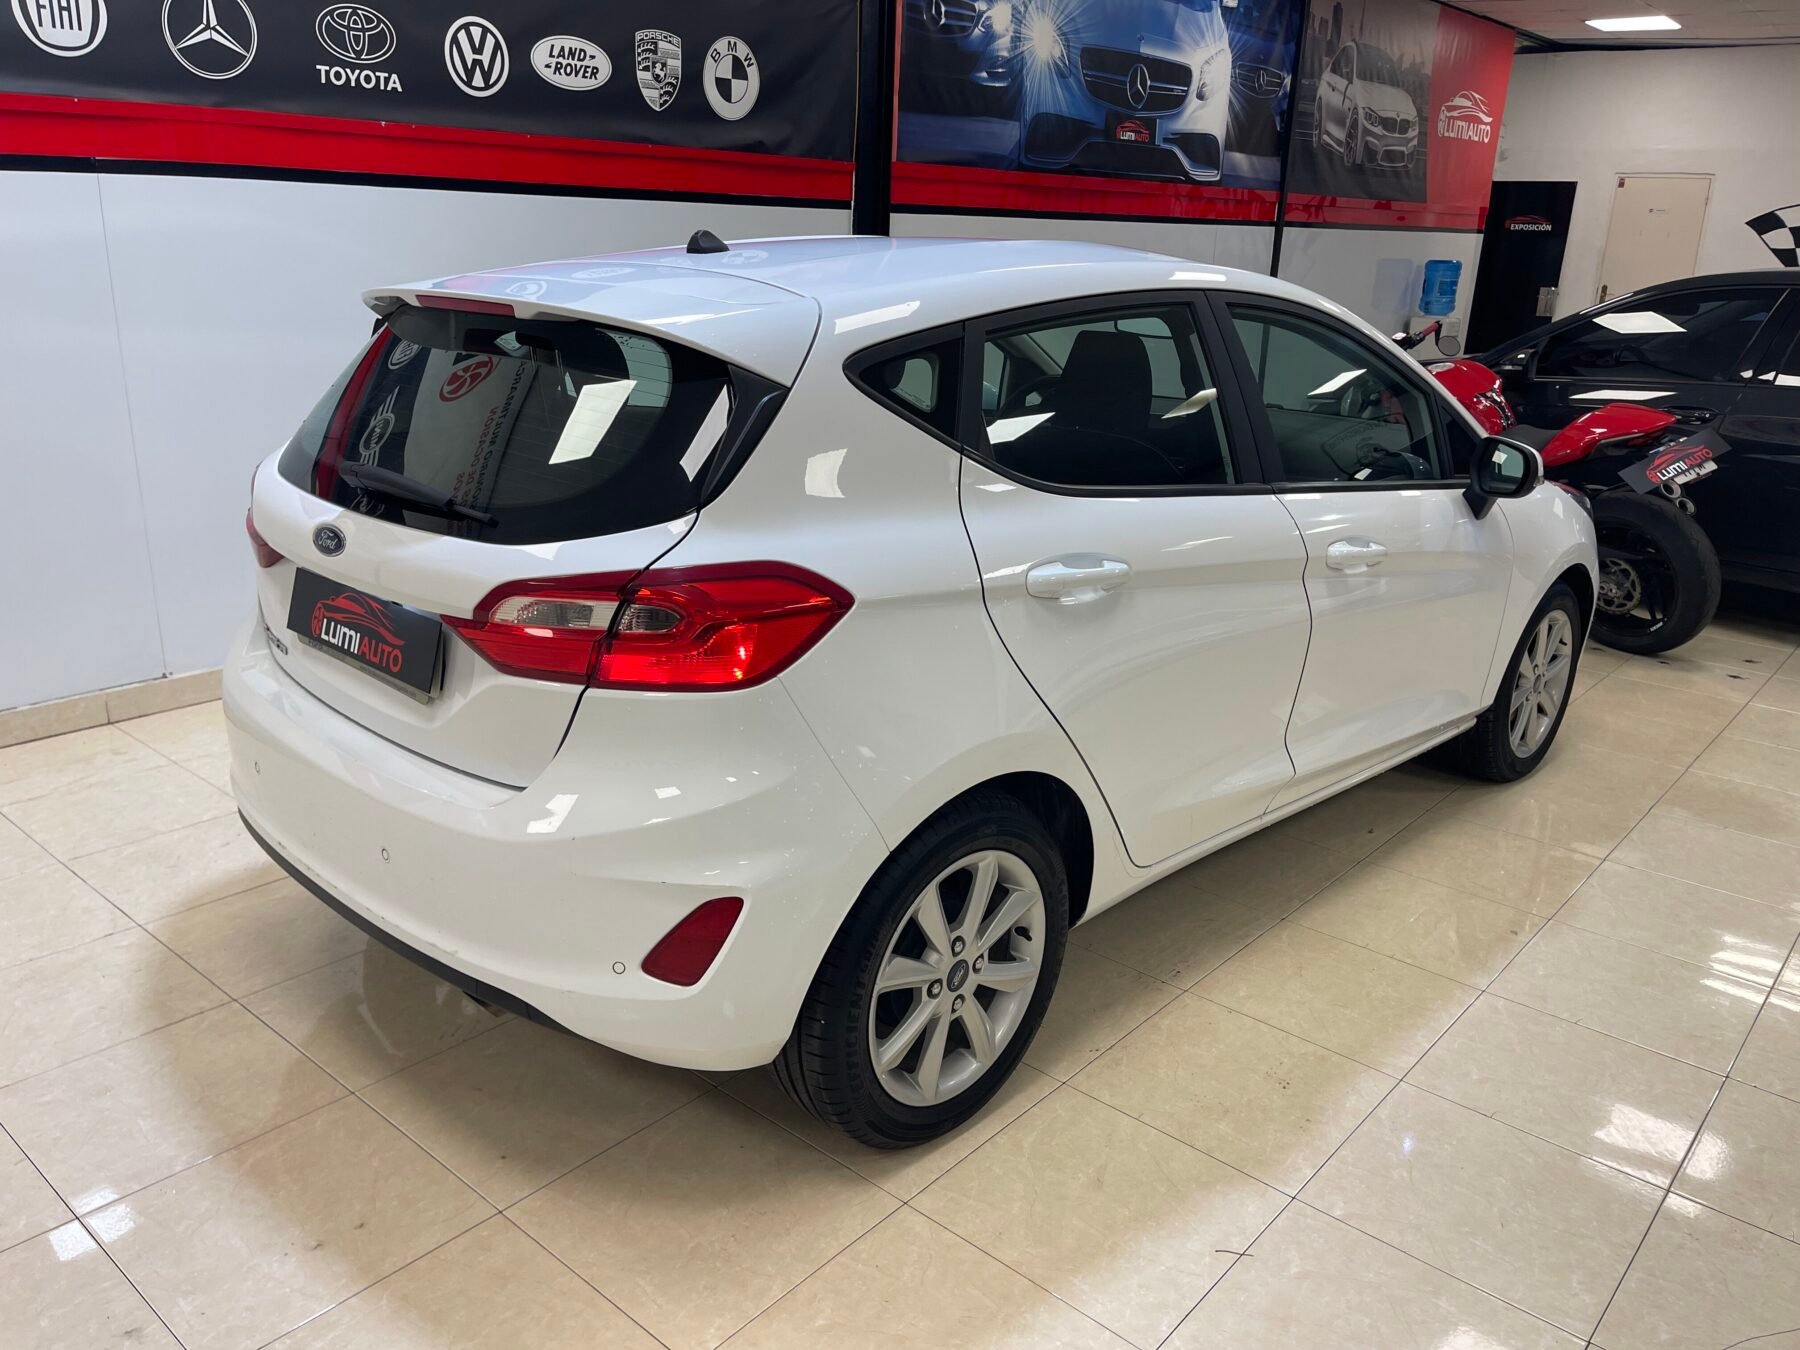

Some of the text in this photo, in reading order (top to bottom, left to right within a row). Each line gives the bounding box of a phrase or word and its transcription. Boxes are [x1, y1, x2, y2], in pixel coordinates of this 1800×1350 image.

[637, 31, 680, 47] PORSCHE
[548, 43, 587, 63] LAND
[710, 40, 754, 69] BMW
[315, 64, 403, 92] TOYOTA
[552, 60, 600, 81] ROVER
[1444, 117, 1491, 144] LUMIAUTO
[1510, 222, 1552, 231] EXPOSICIÓN
[1657, 448, 1713, 481] LUMIAUTO
[317, 529, 338, 550] Ford
[320, 618, 403, 673] LUMIAUTO
